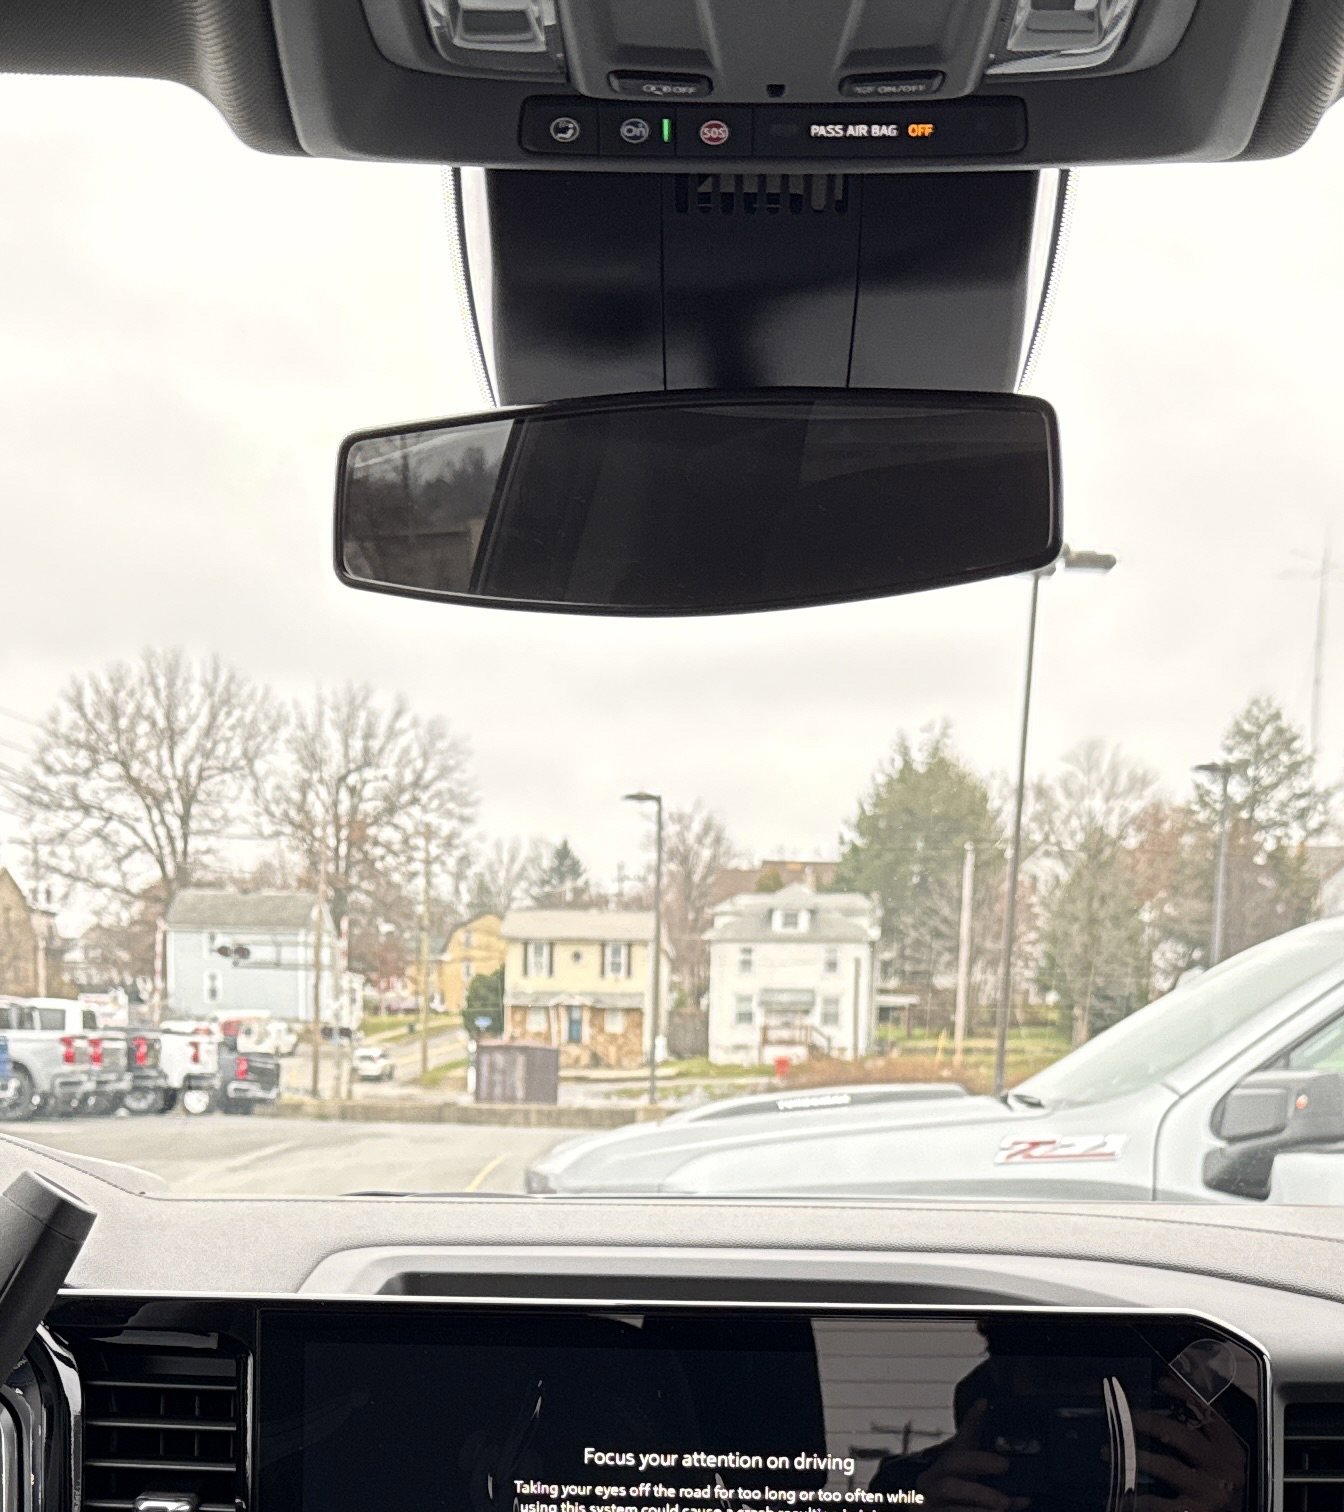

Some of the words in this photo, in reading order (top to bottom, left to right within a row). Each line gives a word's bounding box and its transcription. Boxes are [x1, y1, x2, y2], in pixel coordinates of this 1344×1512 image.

[703, 126, 726, 138] SOS
[811, 125, 844, 137] PASS
[846, 125, 868, 136] AIR
[871, 125, 897, 136] BAG
[908, 124, 933, 136] OFF
[584, 1448, 635, 1465] Focus
[639, 1454, 678, 1471] your
[682, 1452, 762, 1468] attention
[767, 1457, 789, 1469] on
[794, 1452, 855, 1475] driving
[514, 1480, 558, 1498] Taking
[561, 1485, 592, 1498] your
[595, 1486, 626, 1499] eyes
[629, 1483, 651, 1496] off
[653, 1483, 676, 1497] the
[679, 1485, 711, 1498] road
[714, 1484, 735, 1500] for
[737, 1487, 761, 1500] too
[765, 1486, 796, 1504] long
[799, 1491, 815, 1501] or
[817, 1489, 843, 1502] too
[844, 1488, 883, 1503] often
[887, 1489, 924, 1504] while
